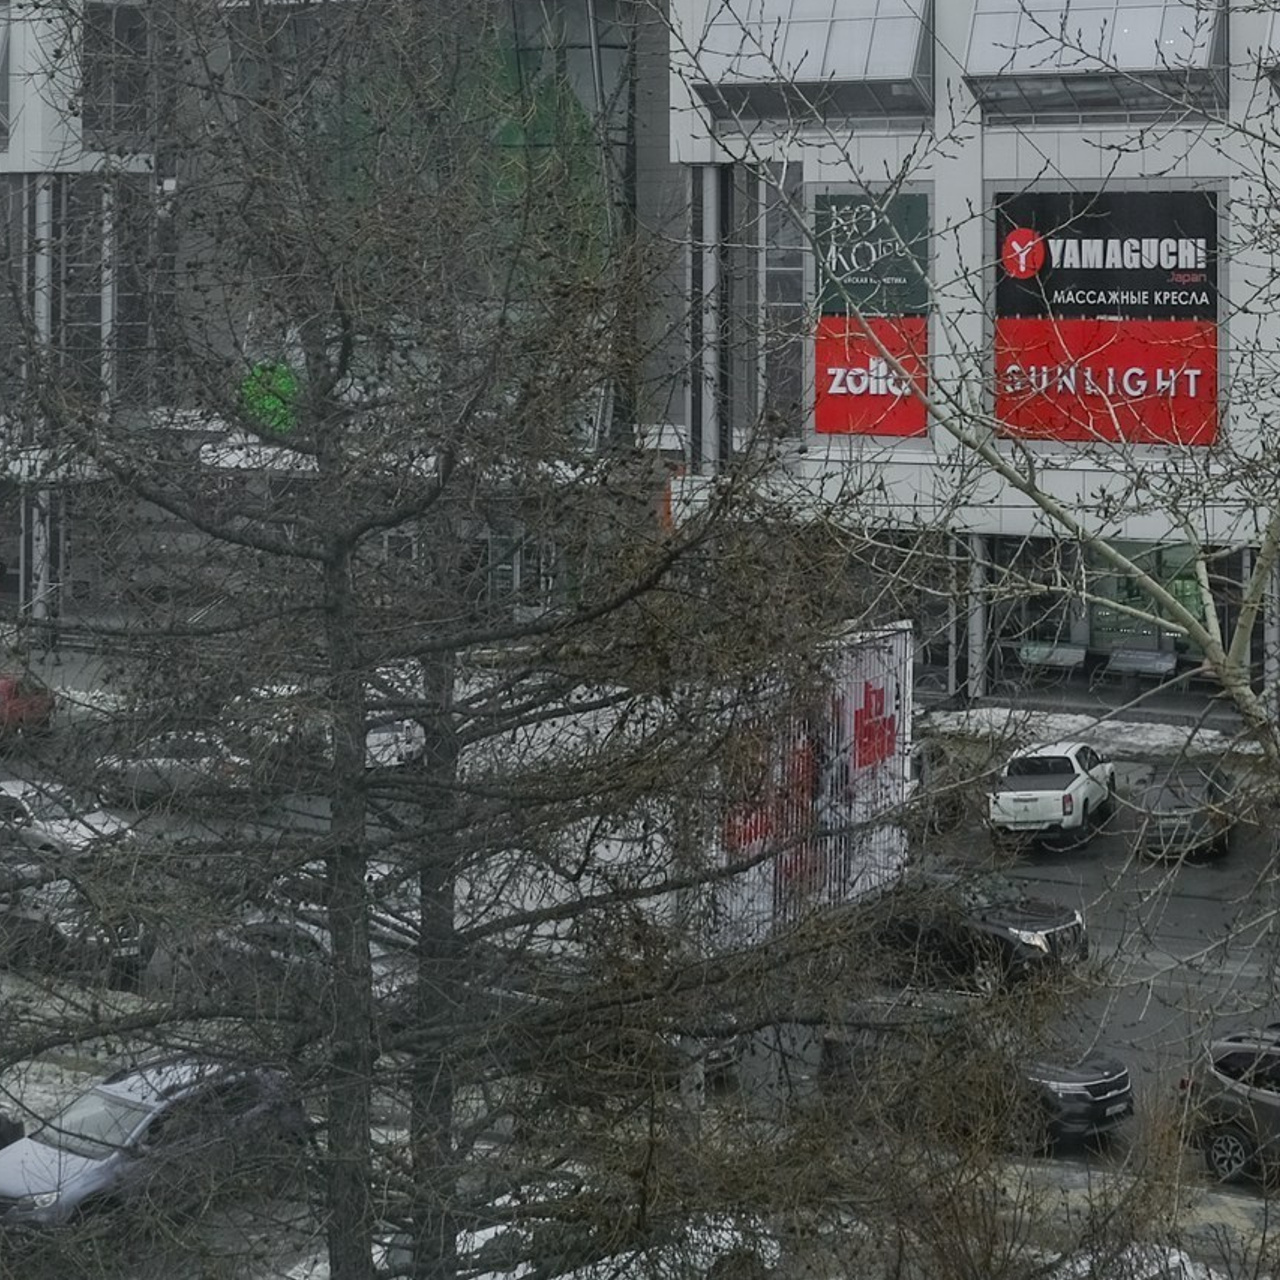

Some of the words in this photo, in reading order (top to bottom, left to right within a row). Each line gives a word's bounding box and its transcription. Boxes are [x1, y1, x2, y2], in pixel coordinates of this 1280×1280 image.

[1048, 237, 1207, 270] YAMAGUCHI
[1167, 271, 1207, 285] Japan
[1053, 290, 1149, 305] МАССАЖНЫЕ
[1153, 291, 1210, 306] КРЕСЛА
[827, 357, 912, 396] zolla
[1005, 364, 1202, 398] SUNLIGHT
